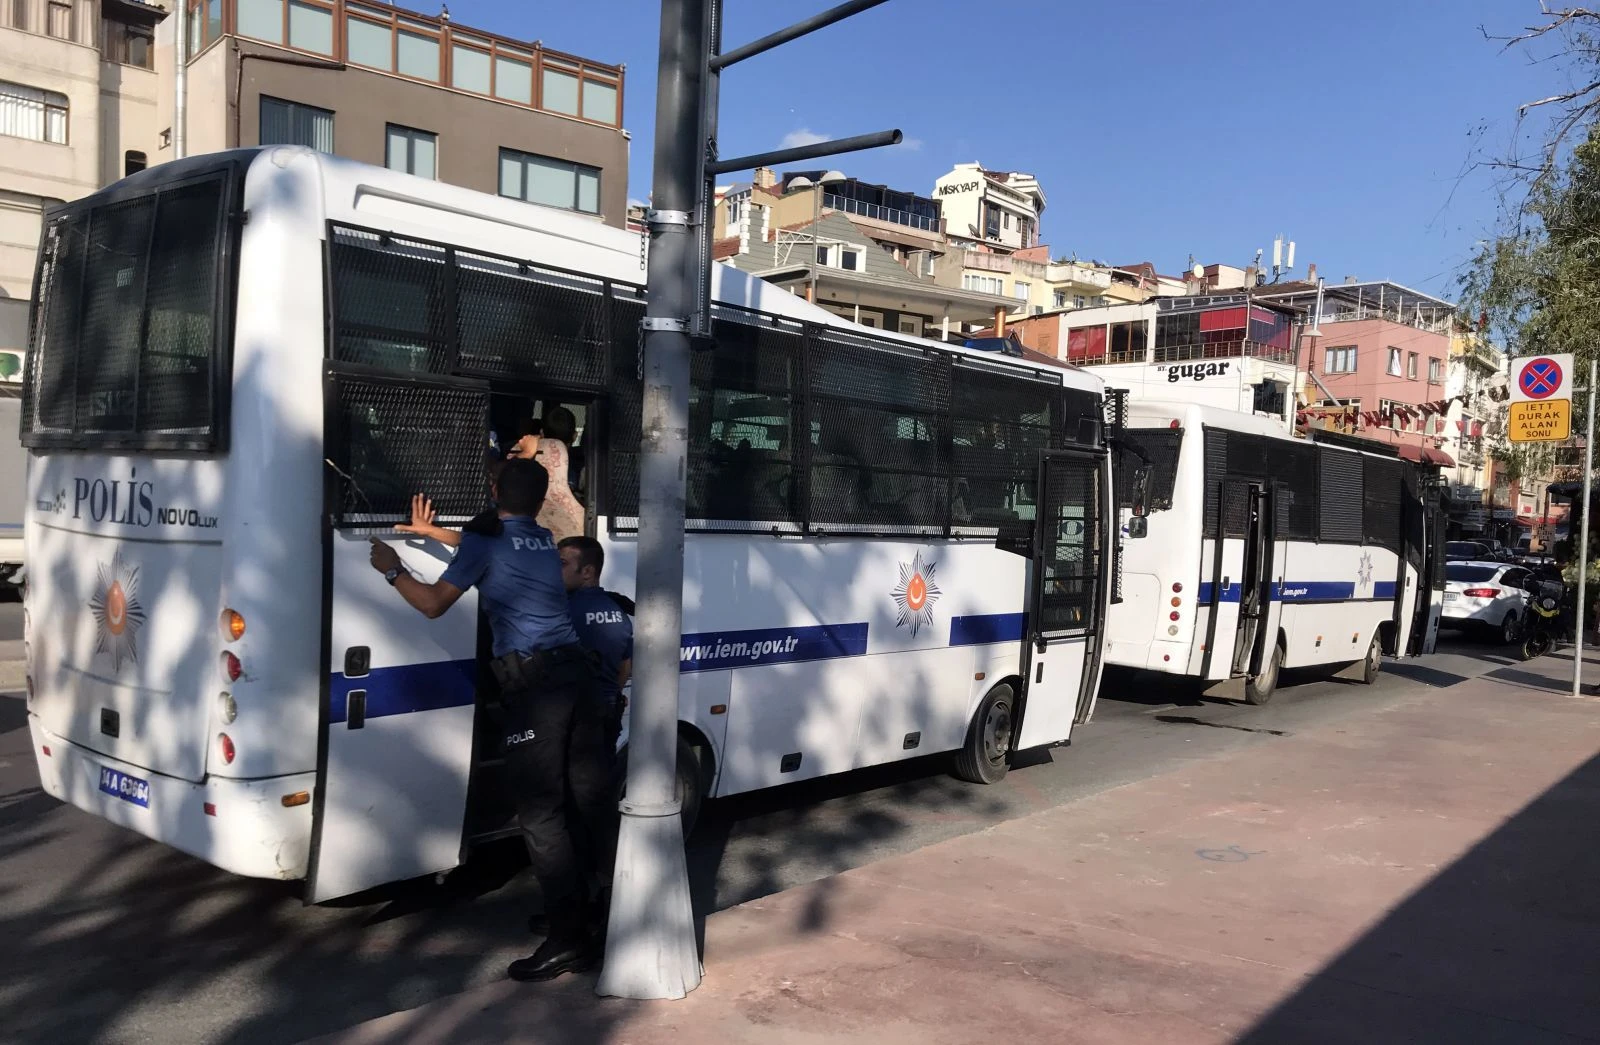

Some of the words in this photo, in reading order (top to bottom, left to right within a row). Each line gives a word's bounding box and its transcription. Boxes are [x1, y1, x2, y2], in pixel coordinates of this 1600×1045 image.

[960, 181, 979, 192] YAPI
[1168, 362, 1230, 382] gugar
[1518, 412, 1560, 421] DURAK
[1521, 421, 1558, 429] ALANI
[1526, 430, 1551, 438] SONU
[72, 466, 153, 528] POLİS
[680, 635, 799, 662] ww.iem.gov.tr
[110, 773, 118, 791] A
